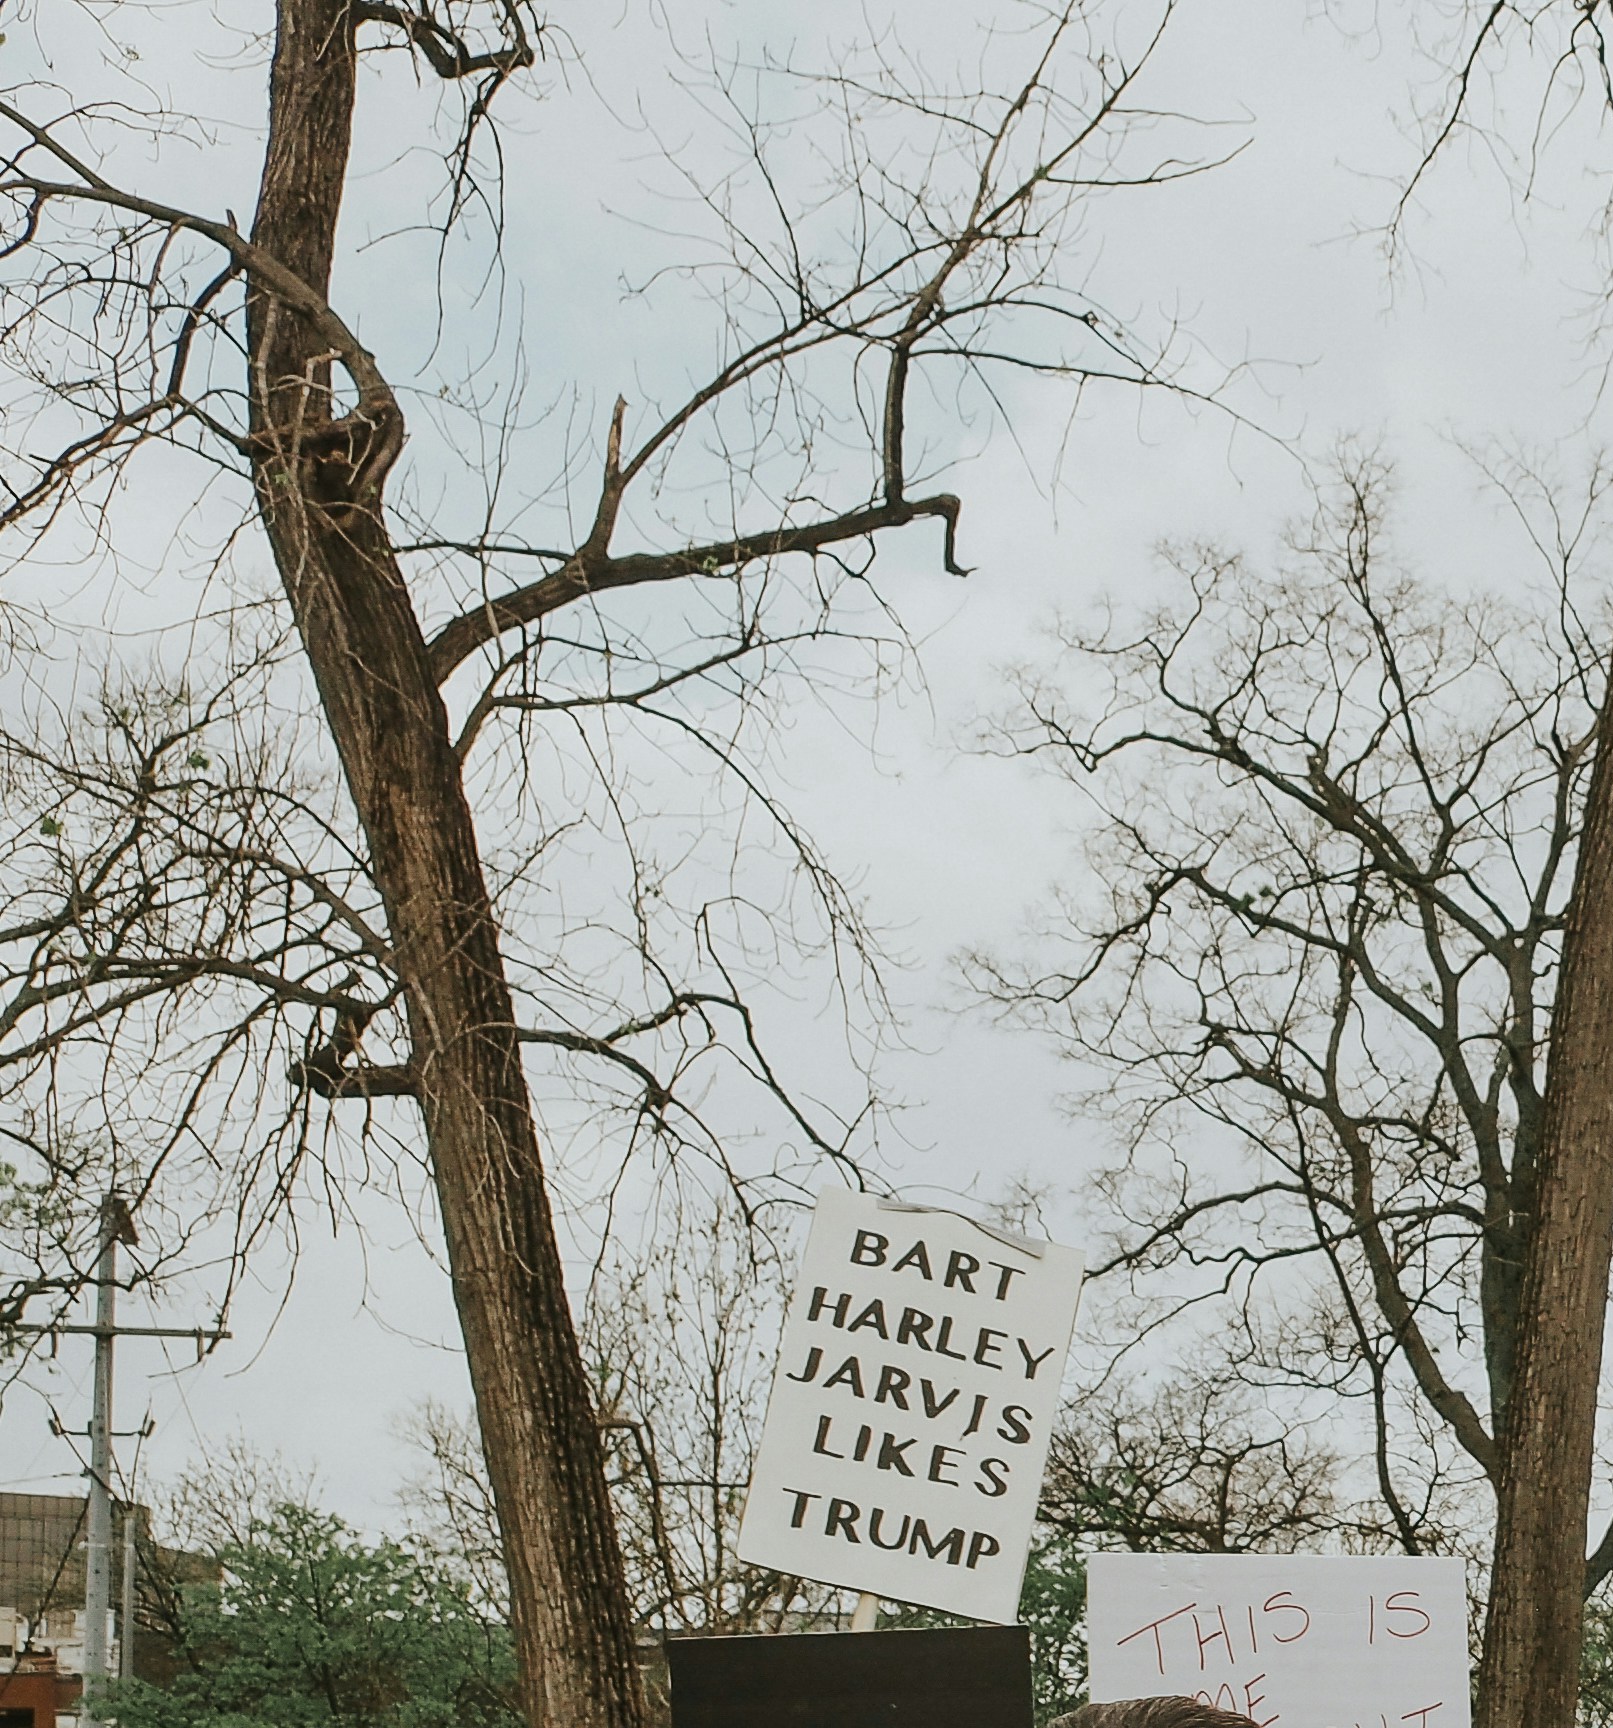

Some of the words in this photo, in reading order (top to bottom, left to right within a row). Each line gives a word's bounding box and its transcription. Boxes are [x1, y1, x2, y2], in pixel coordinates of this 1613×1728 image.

[850, 1229, 1026, 1301] BART
[806, 1286, 1056, 1382] HARLEY
[785, 1346, 1035, 1446] JARVIS
[813, 1414, 1011, 1498] LIKES
[782, 1487, 1000, 1571] TRUMP
[1117, 1591, 1310, 1675] THIS
[1367, 1591, 1431, 1645] IS
